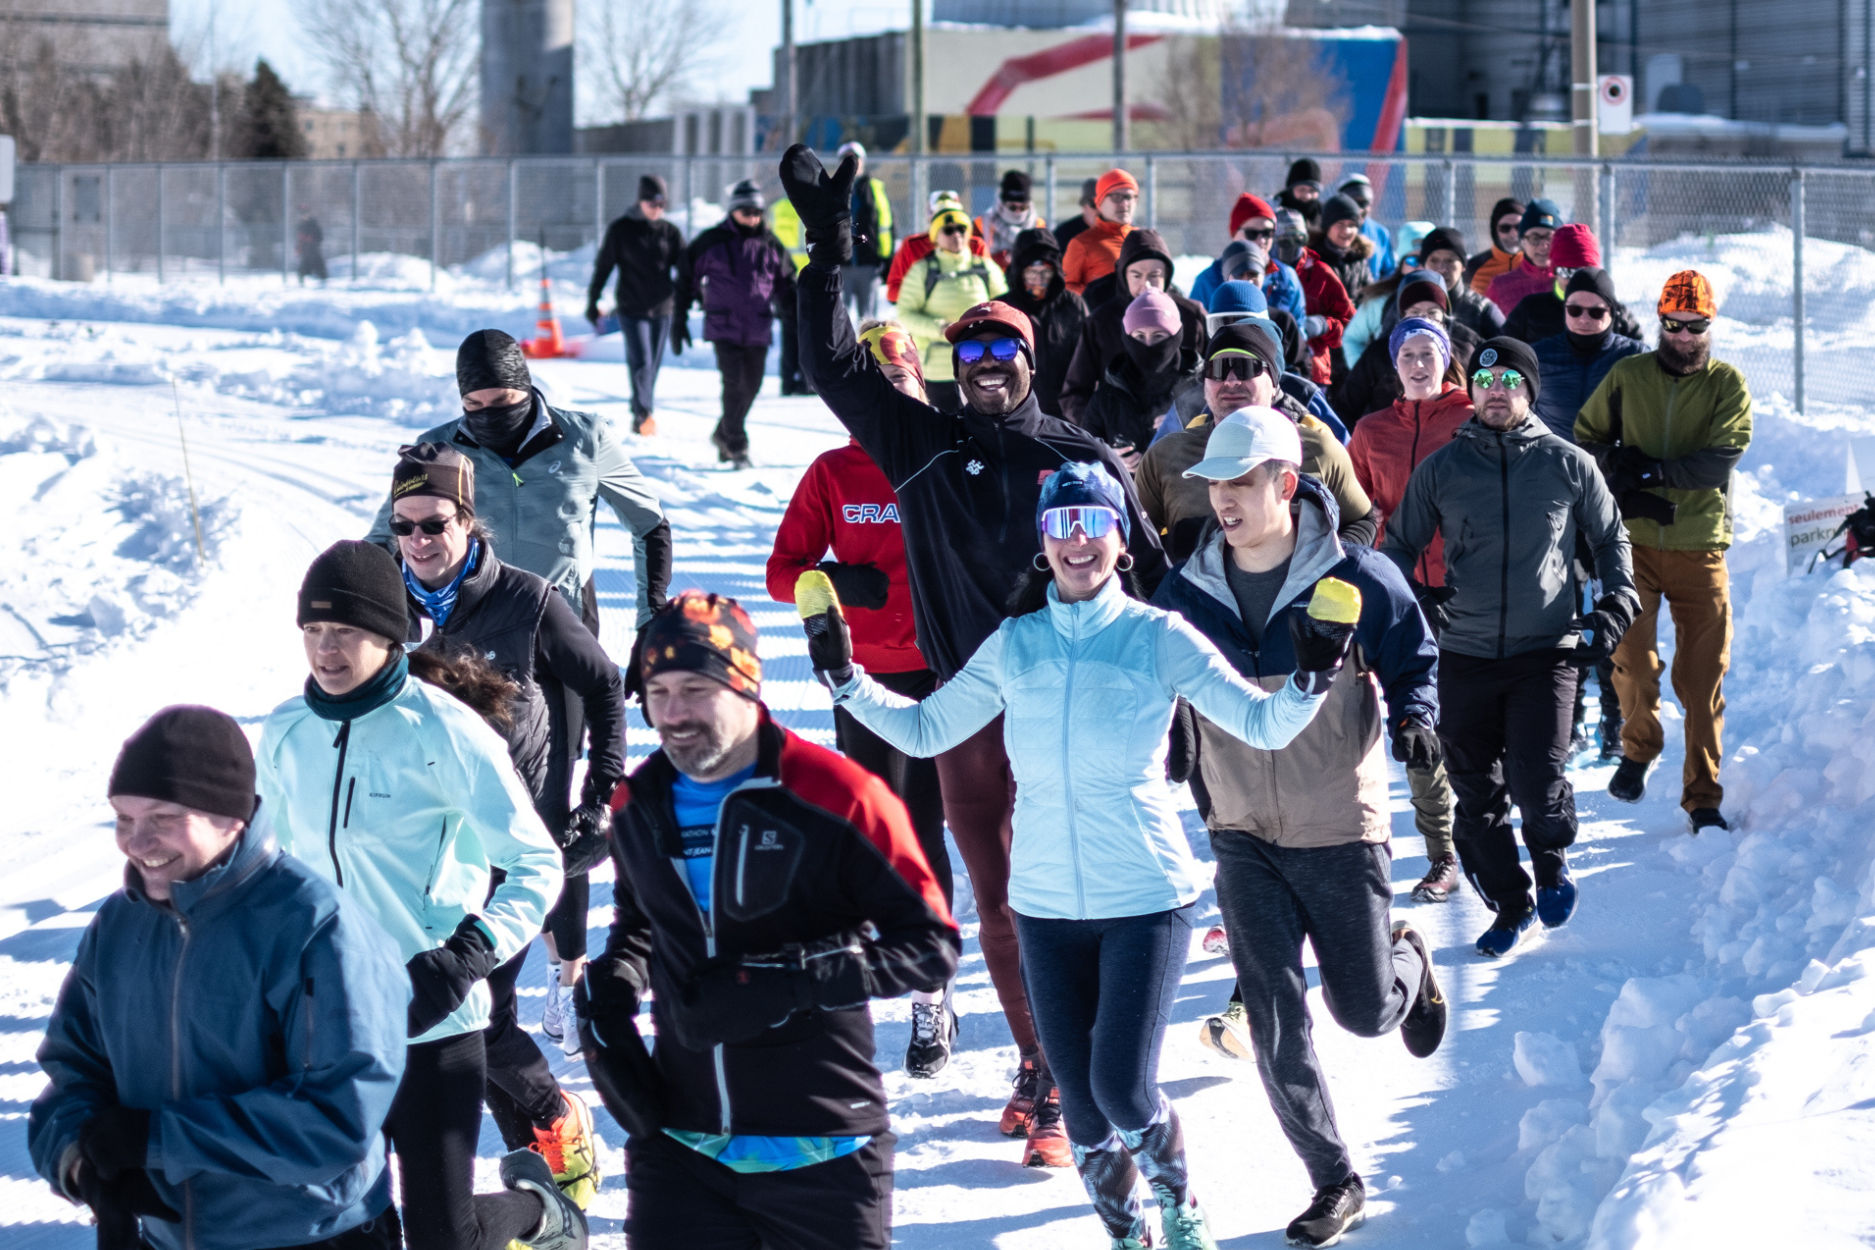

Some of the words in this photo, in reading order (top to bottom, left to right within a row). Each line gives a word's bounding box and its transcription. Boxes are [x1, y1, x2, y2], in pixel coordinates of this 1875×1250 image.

[842, 503, 901, 523] CRA
[1789, 503, 1859, 524] seulement
[1790, 526, 1846, 547] parkr
